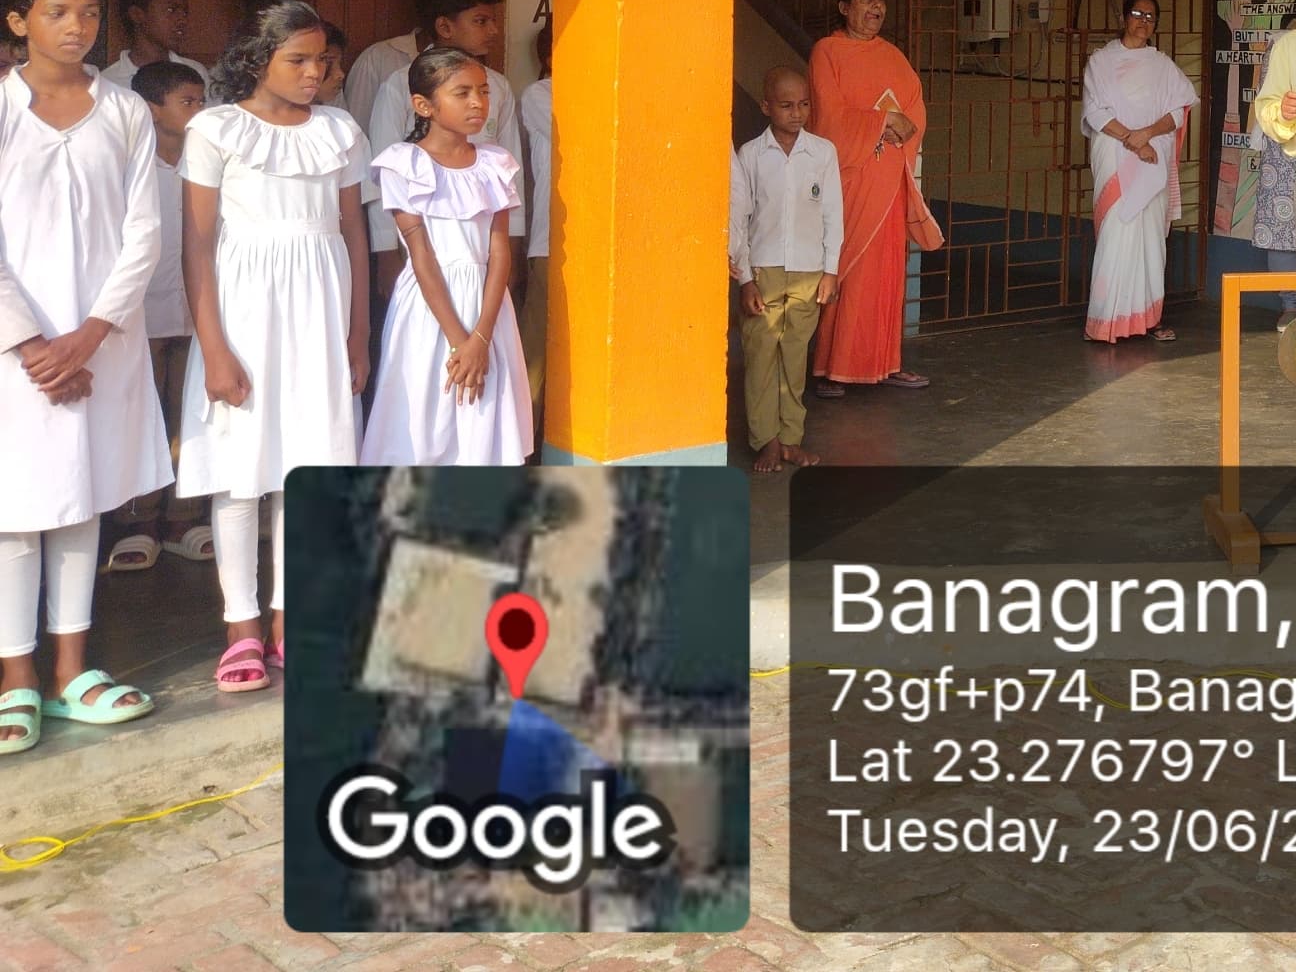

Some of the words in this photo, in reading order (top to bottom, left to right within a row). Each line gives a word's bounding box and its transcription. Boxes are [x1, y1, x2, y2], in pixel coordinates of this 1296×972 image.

[1243, 4, 1263, 15] THE
[1236, 31, 1254, 42] BUT
[1217, 52, 1223, 62] A
[1226, 51, 1254, 64] HEART
